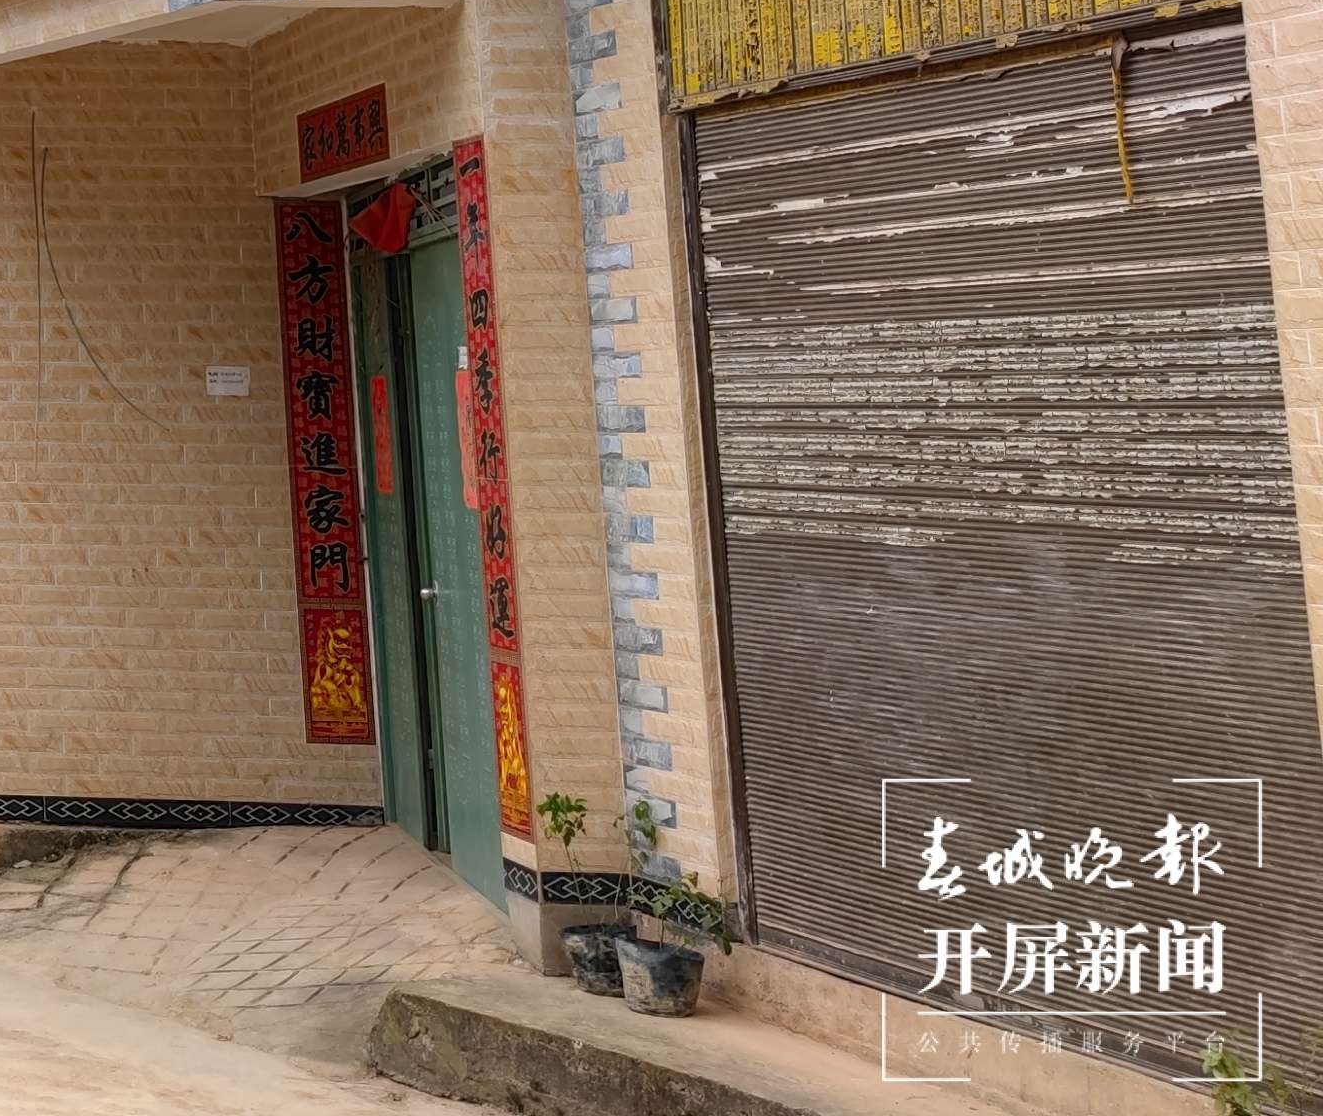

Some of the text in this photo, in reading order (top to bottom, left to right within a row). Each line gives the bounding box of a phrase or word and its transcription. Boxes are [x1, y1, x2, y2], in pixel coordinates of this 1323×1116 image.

[302, 98, 384, 171] 家和萬事興
[284, 209, 349, 593] 八方財寶進家門
[458, 158, 515, 641] 一年四季行好運
